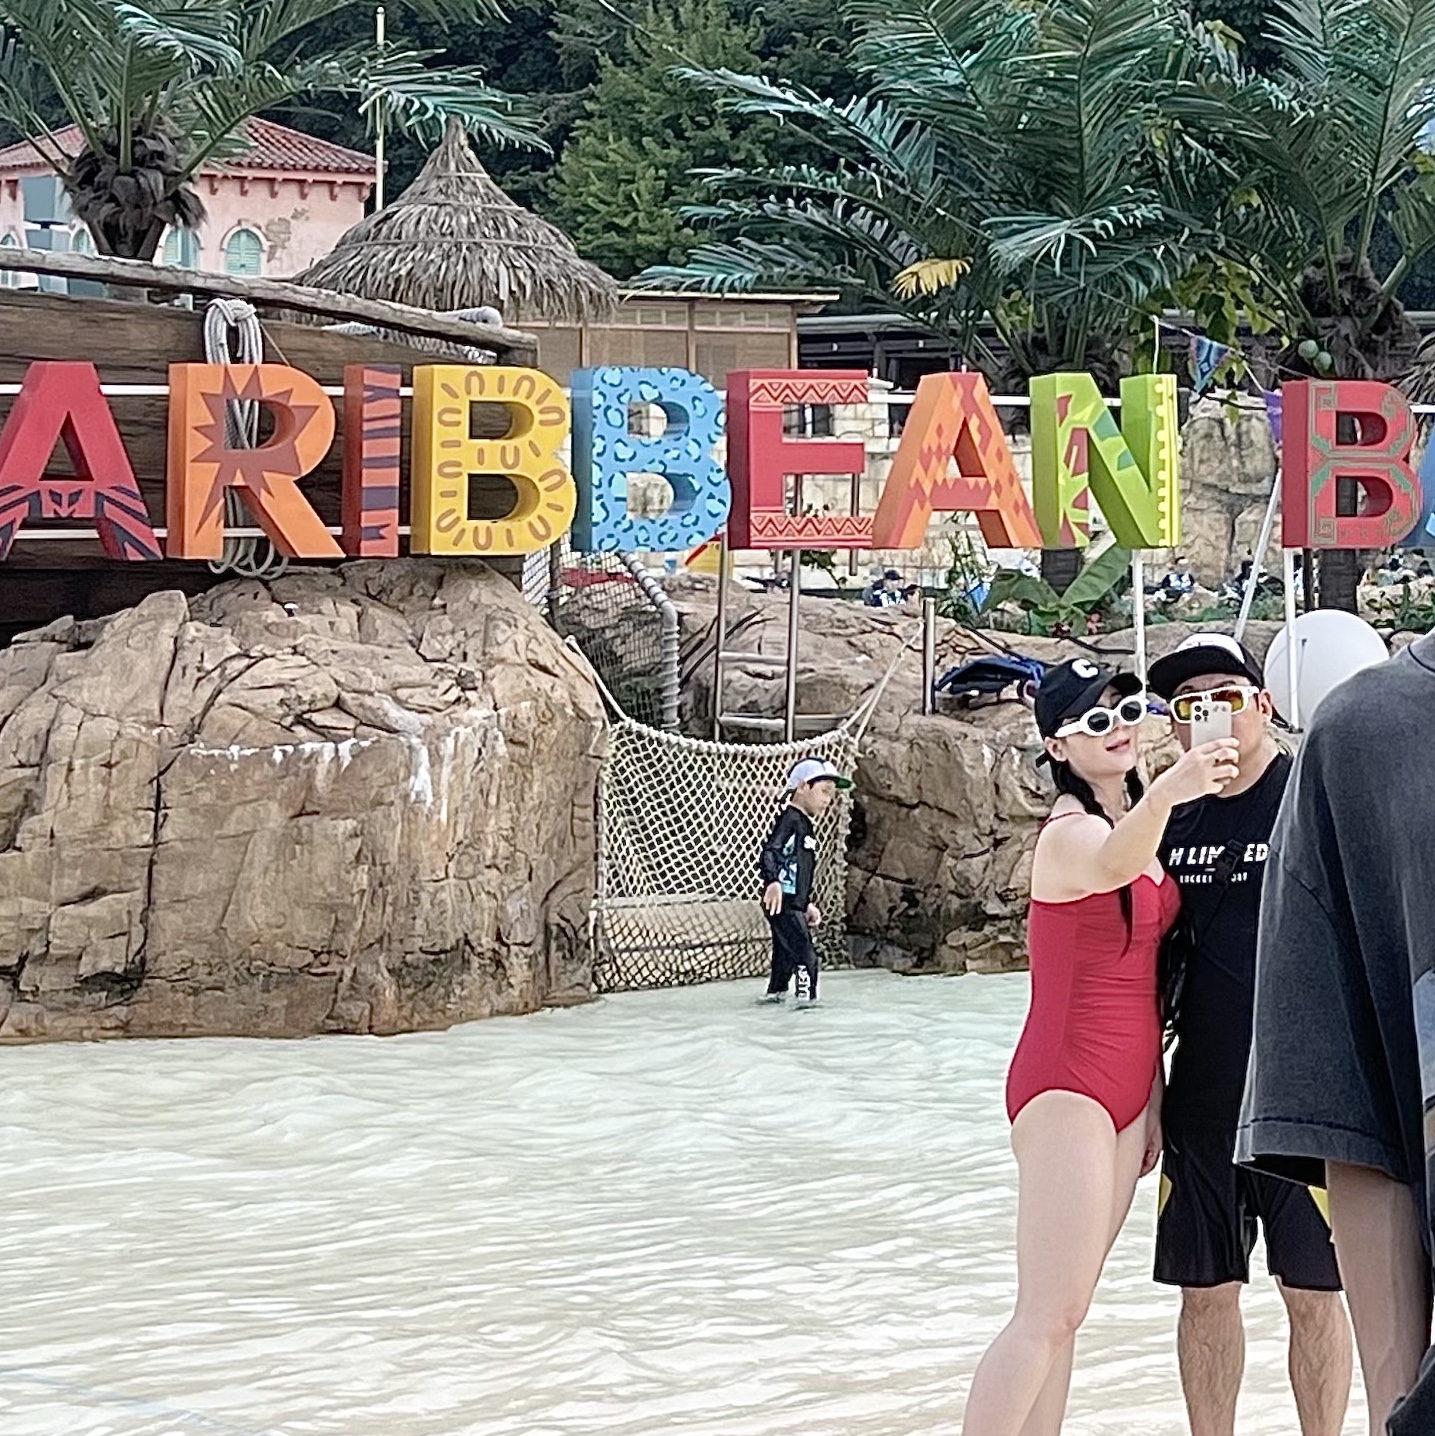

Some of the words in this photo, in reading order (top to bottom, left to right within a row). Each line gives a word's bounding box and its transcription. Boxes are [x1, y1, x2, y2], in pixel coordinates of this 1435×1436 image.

[0, 361, 1179, 559] ARIBBEAN
[1072, 658, 1098, 678] C
[1187, 843, 1269, 864] LIMED
